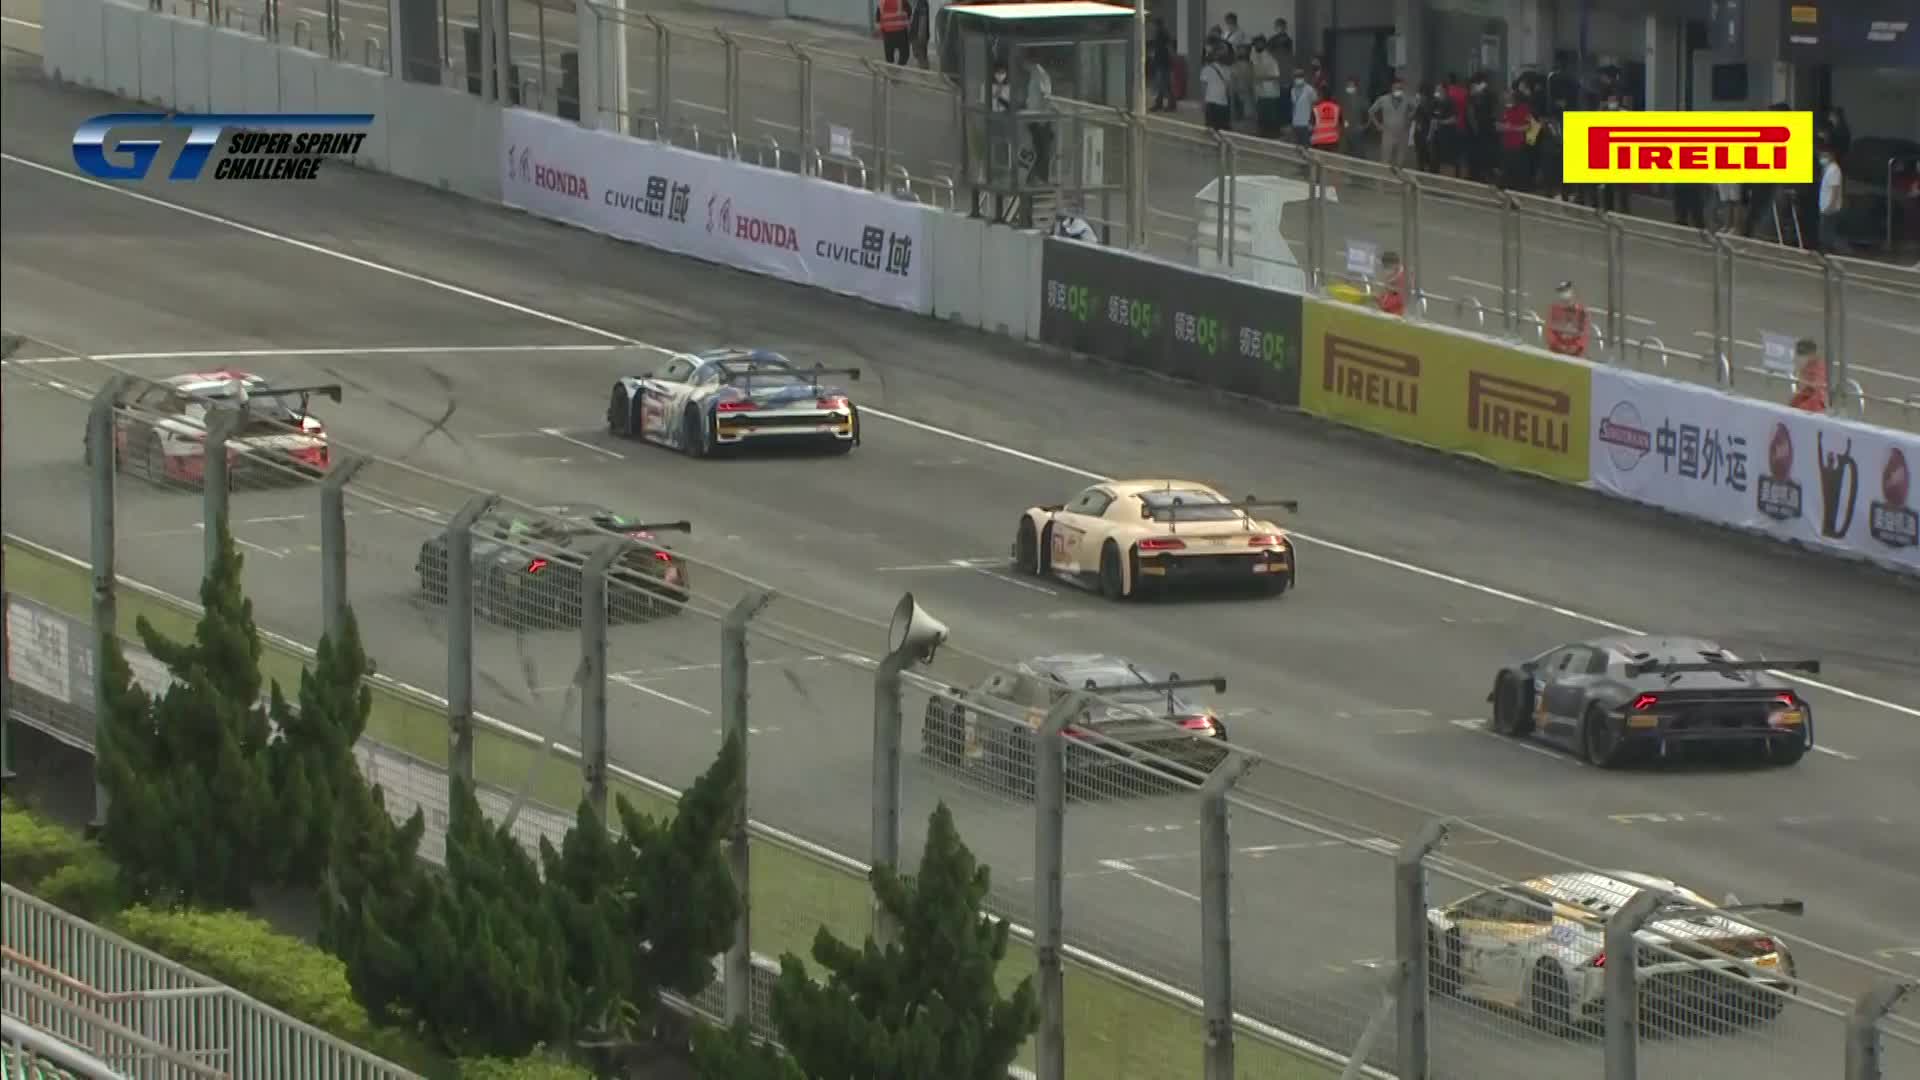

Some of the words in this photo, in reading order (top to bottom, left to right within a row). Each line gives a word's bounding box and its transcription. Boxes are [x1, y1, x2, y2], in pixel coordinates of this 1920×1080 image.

[535, 164, 589, 200] HONDA
[604, 188, 645, 214] CIVIC
[646, 175, 691, 224] 思域
[736, 215, 800, 252] HONDA
[815, 240, 861, 266] CIVIC
[861, 224, 912, 277] 思域
[1323, 332, 1420, 415] PIRELLI
[1468, 369, 1571, 454] PIRELLI
[1656, 416, 1748, 493] 中国外运
